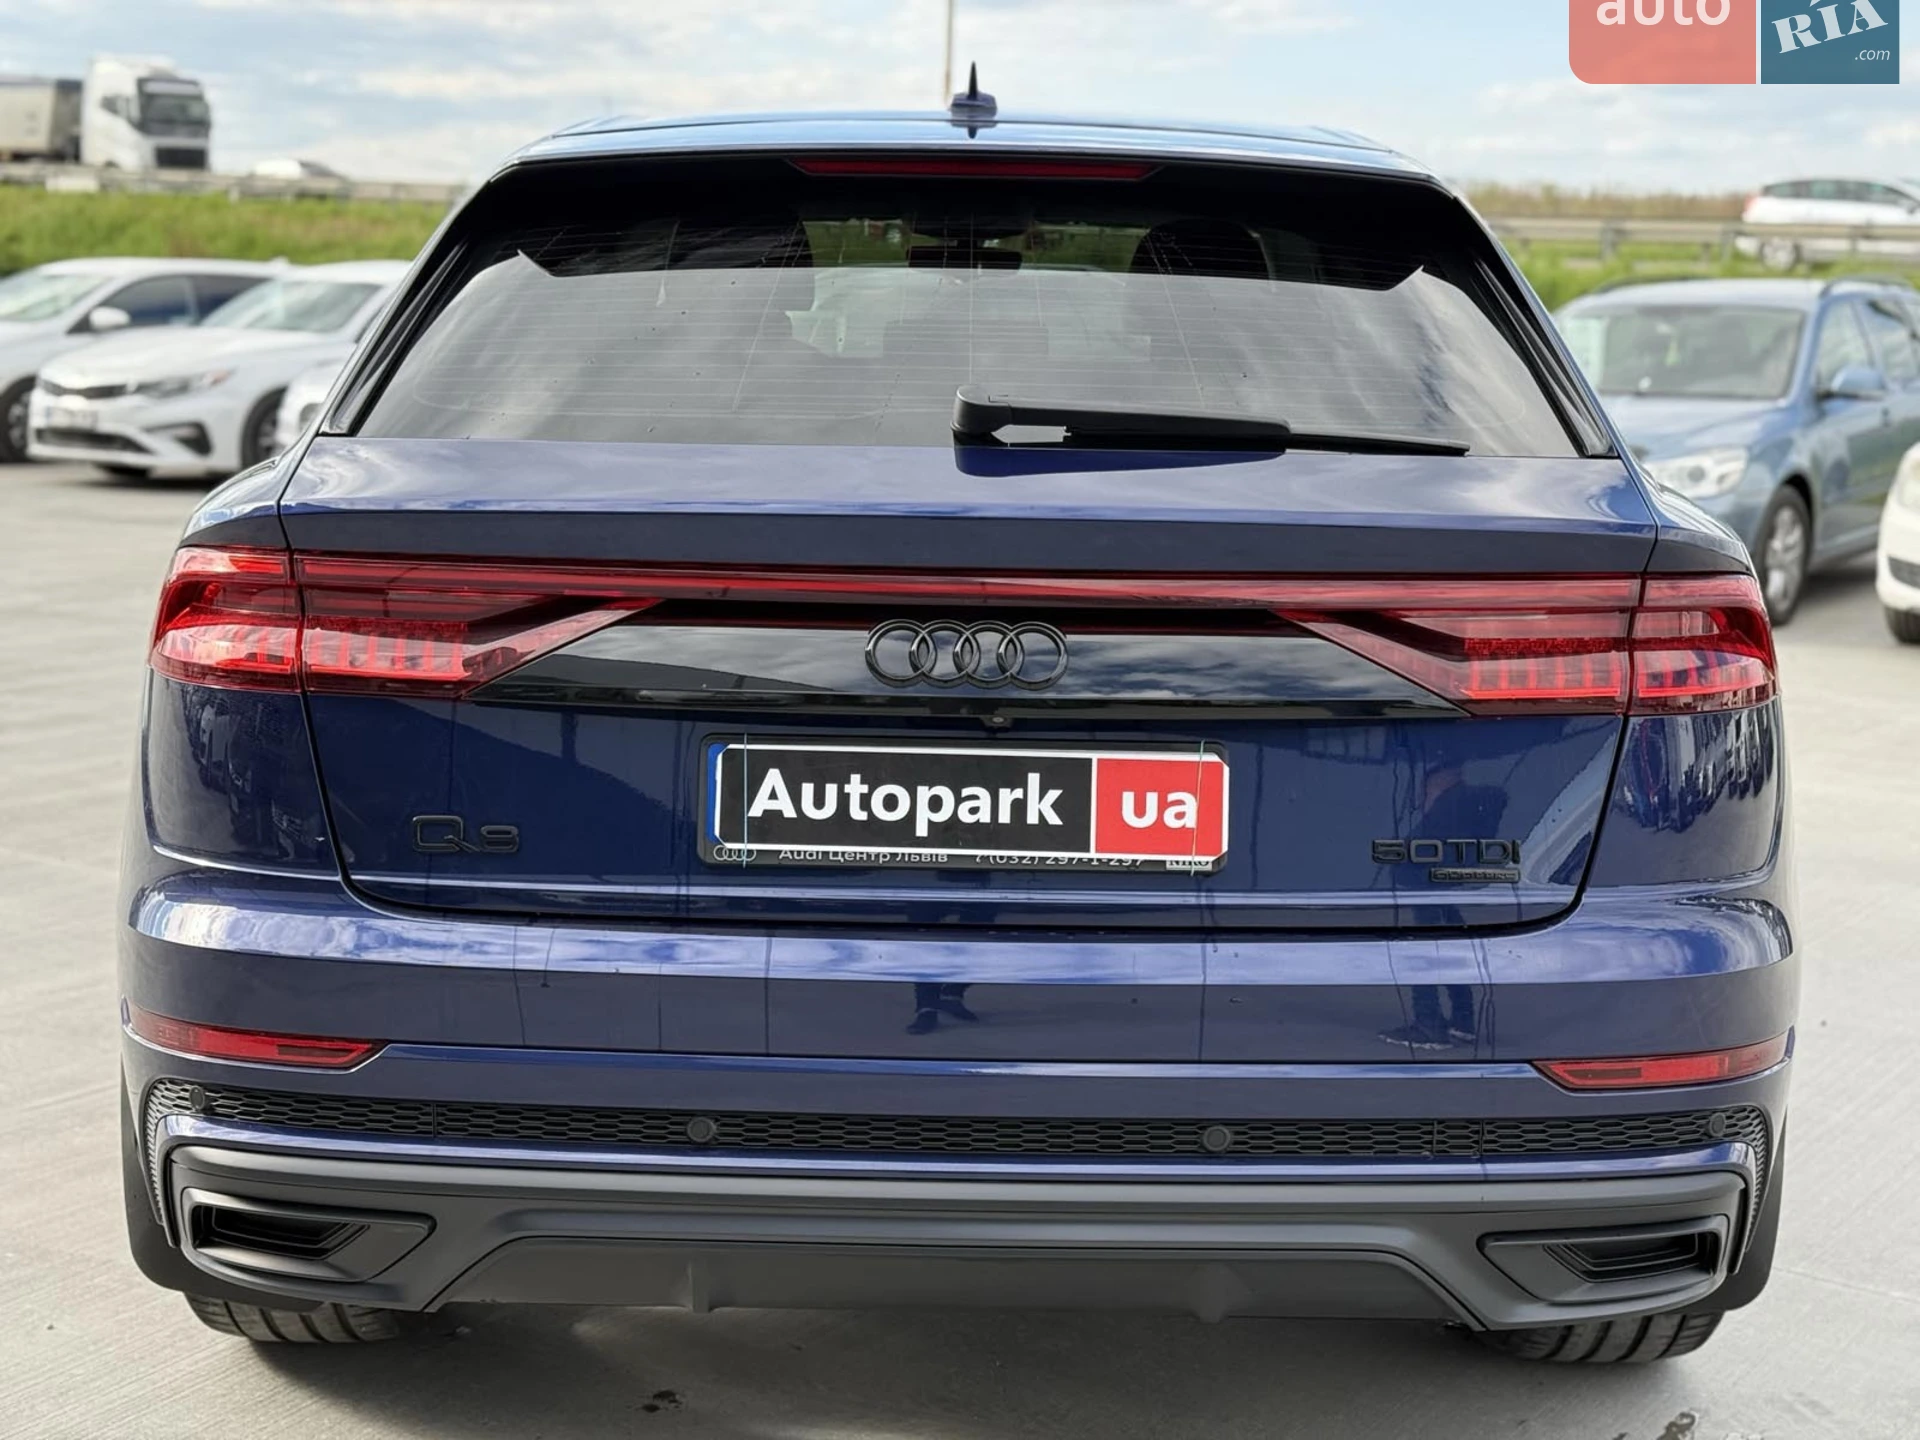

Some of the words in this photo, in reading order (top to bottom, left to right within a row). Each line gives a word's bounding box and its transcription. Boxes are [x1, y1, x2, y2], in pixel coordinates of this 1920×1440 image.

[747, 768, 1063, 838] Autopark
[1121, 790, 1198, 829] ua
[412, 815, 519, 852] Q8
[779, 850, 822, 860] Audi
[829, 851, 891, 864] Центр
